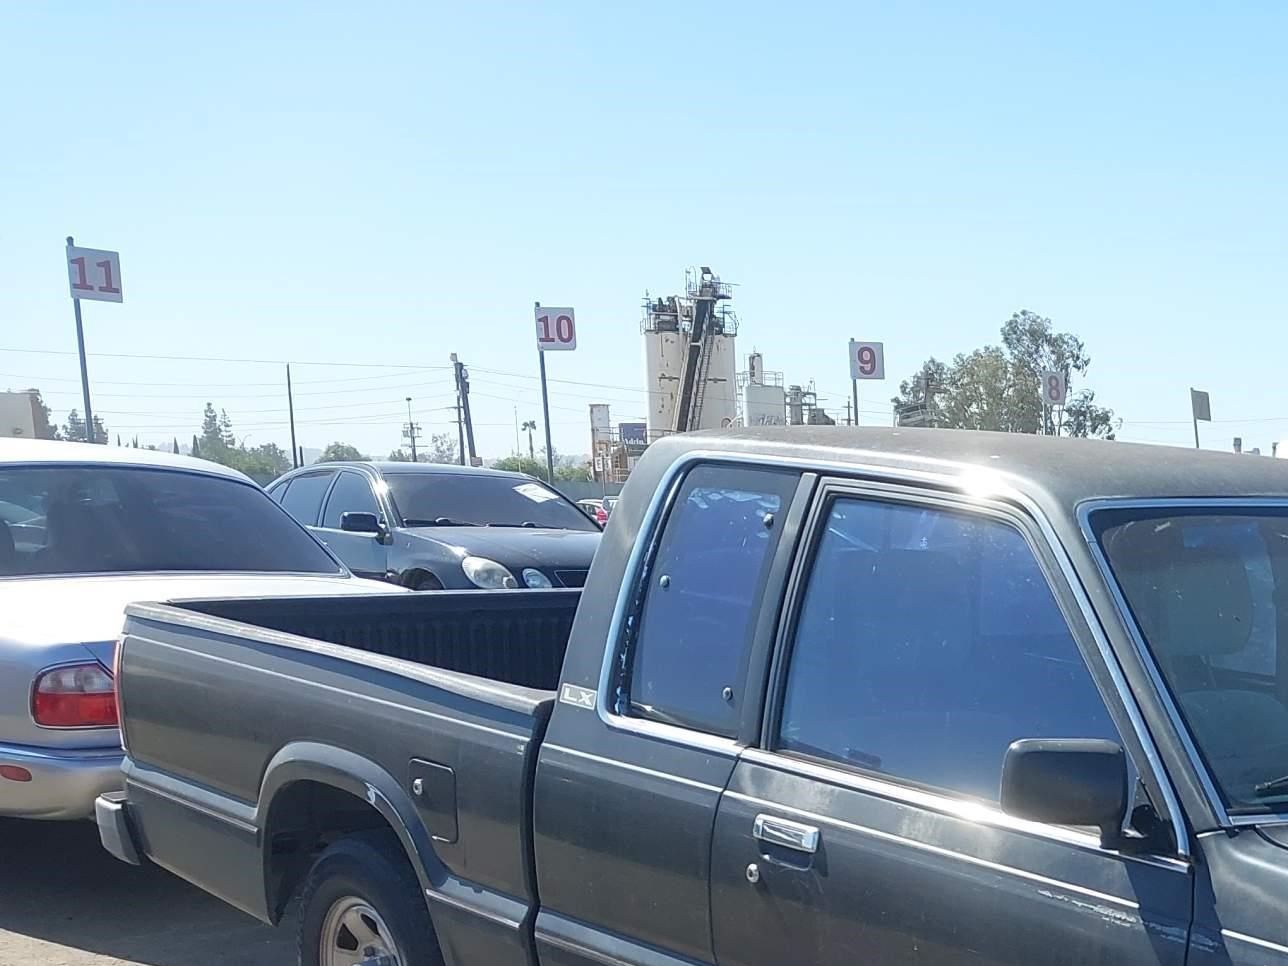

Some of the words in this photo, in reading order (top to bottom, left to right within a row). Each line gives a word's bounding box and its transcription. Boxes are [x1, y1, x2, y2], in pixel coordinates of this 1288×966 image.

[71, 257, 121, 294] 11
[538, 315, 574, 343] 10
[858, 347, 876, 375] 9
[1047, 375, 1061, 401] 8
[564, 687, 595, 706] LX
